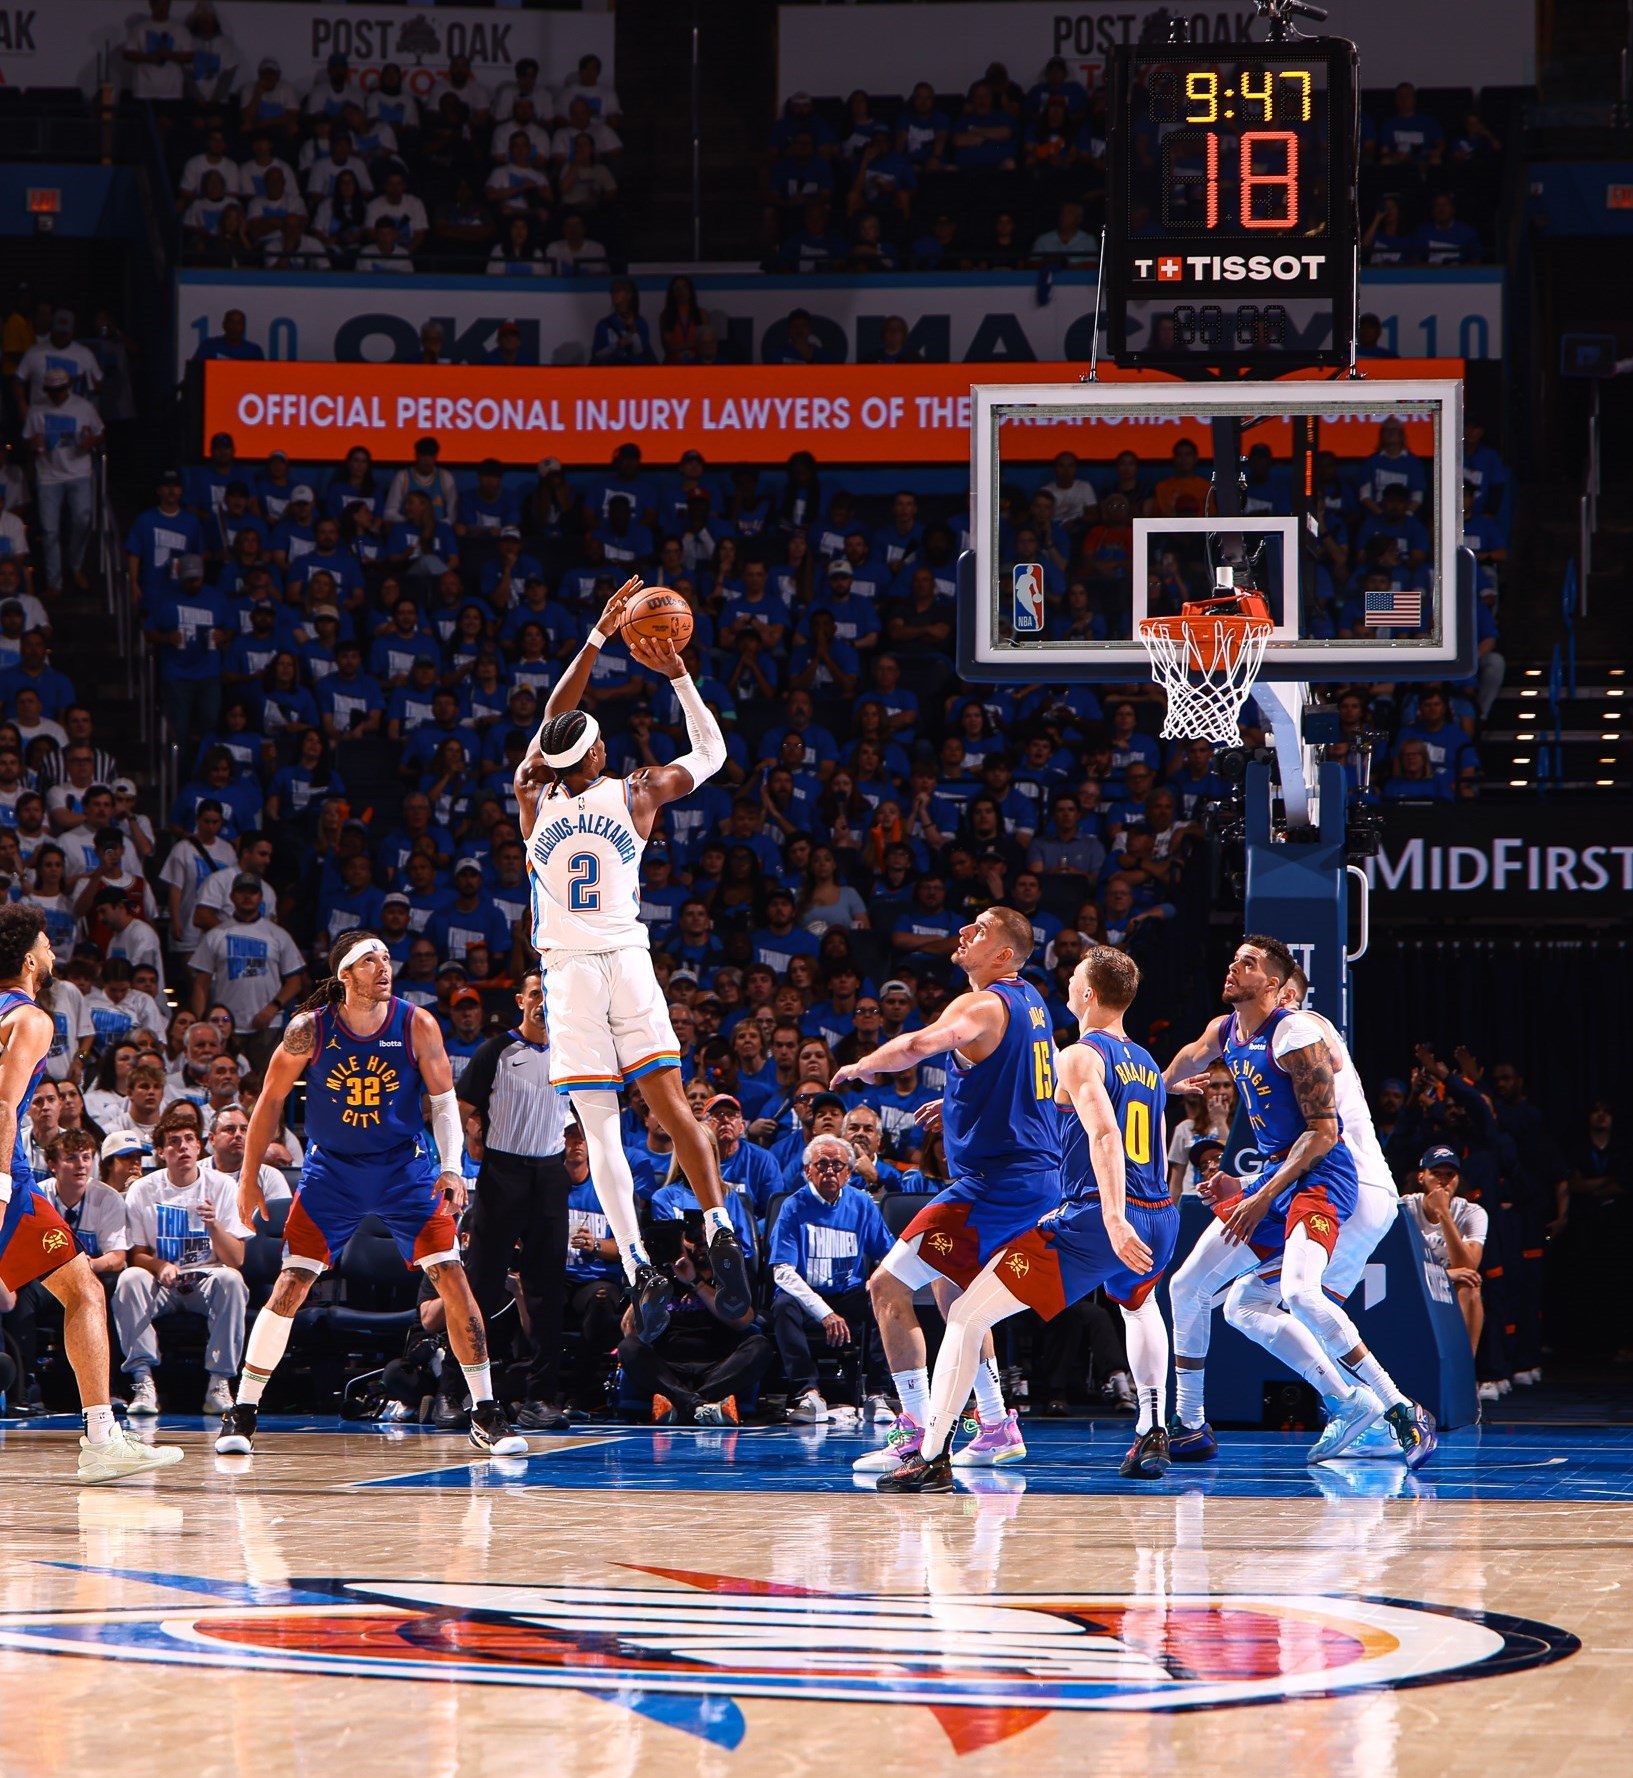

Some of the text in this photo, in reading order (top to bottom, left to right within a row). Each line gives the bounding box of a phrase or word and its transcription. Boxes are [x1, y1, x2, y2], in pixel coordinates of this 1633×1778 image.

[0, 10, 36, 50] AK
[312, 18, 512, 63] POST OAK
[1054, 15, 1136, 56] POST
[1186, 71, 1311, 122] 9:47
[1207, 131, 1298, 229] 18
[1187, 255, 1326, 281] TISSOT
[237, 393, 971, 431] OFFICIAL PERSONAL INJURY LAWYERS OF THE
[1018, 616, 1033, 627] NBA
[533, 813, 637, 866] GILGEOUS-ALEXANDER
[568, 851, 600, 913] 2
[379, 1040, 403, 1048] ibotta
[326, 1055, 400, 1093] MILE HIGH
[1033, 1041, 1053, 1101] 15
[1115, 1061, 1158, 1091] BRAUN
[1242, 1059, 1272, 1097] HIGH
[346, 1076, 381, 1106] 32
[1241, 1081, 1253, 1110] 1
[342, 1109, 381, 1129] CITY
[1124, 1100, 1150, 1165] 0
[1249, 1113, 1267, 1132] ITY
